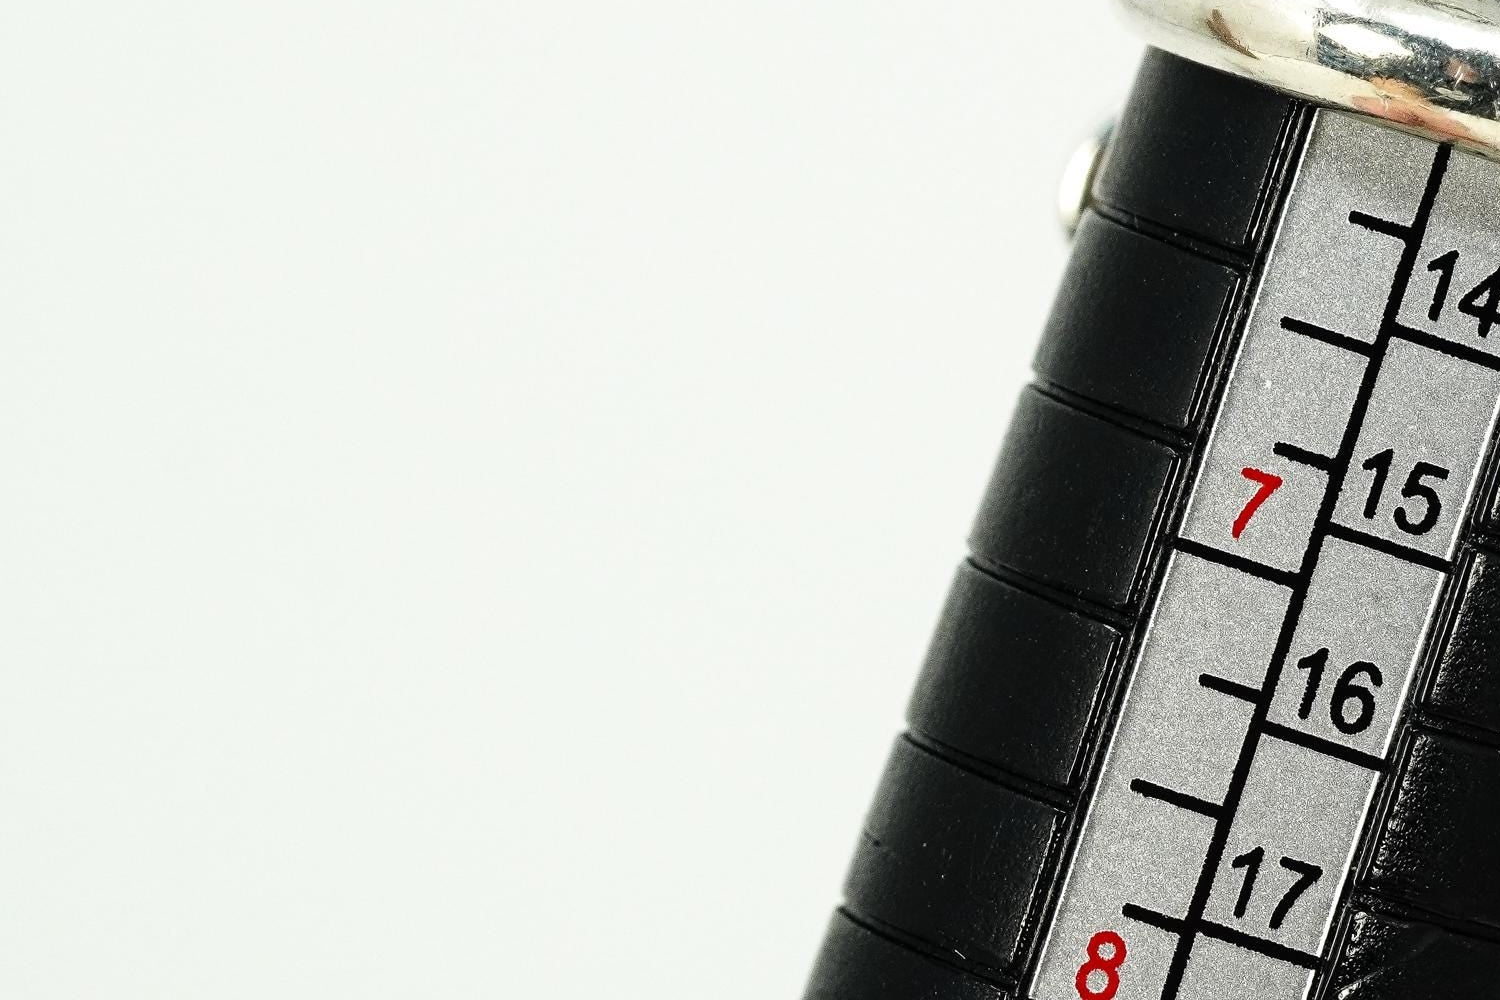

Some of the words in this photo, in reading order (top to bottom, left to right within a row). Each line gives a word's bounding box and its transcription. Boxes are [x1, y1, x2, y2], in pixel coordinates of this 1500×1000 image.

[1231, 467, 1283, 539] 7
[1361, 448, 1450, 536] 15
[1297, 647, 1384, 736] 16
[1232, 846, 1323, 930] 17
[1075, 930, 1127, 1000] 8
